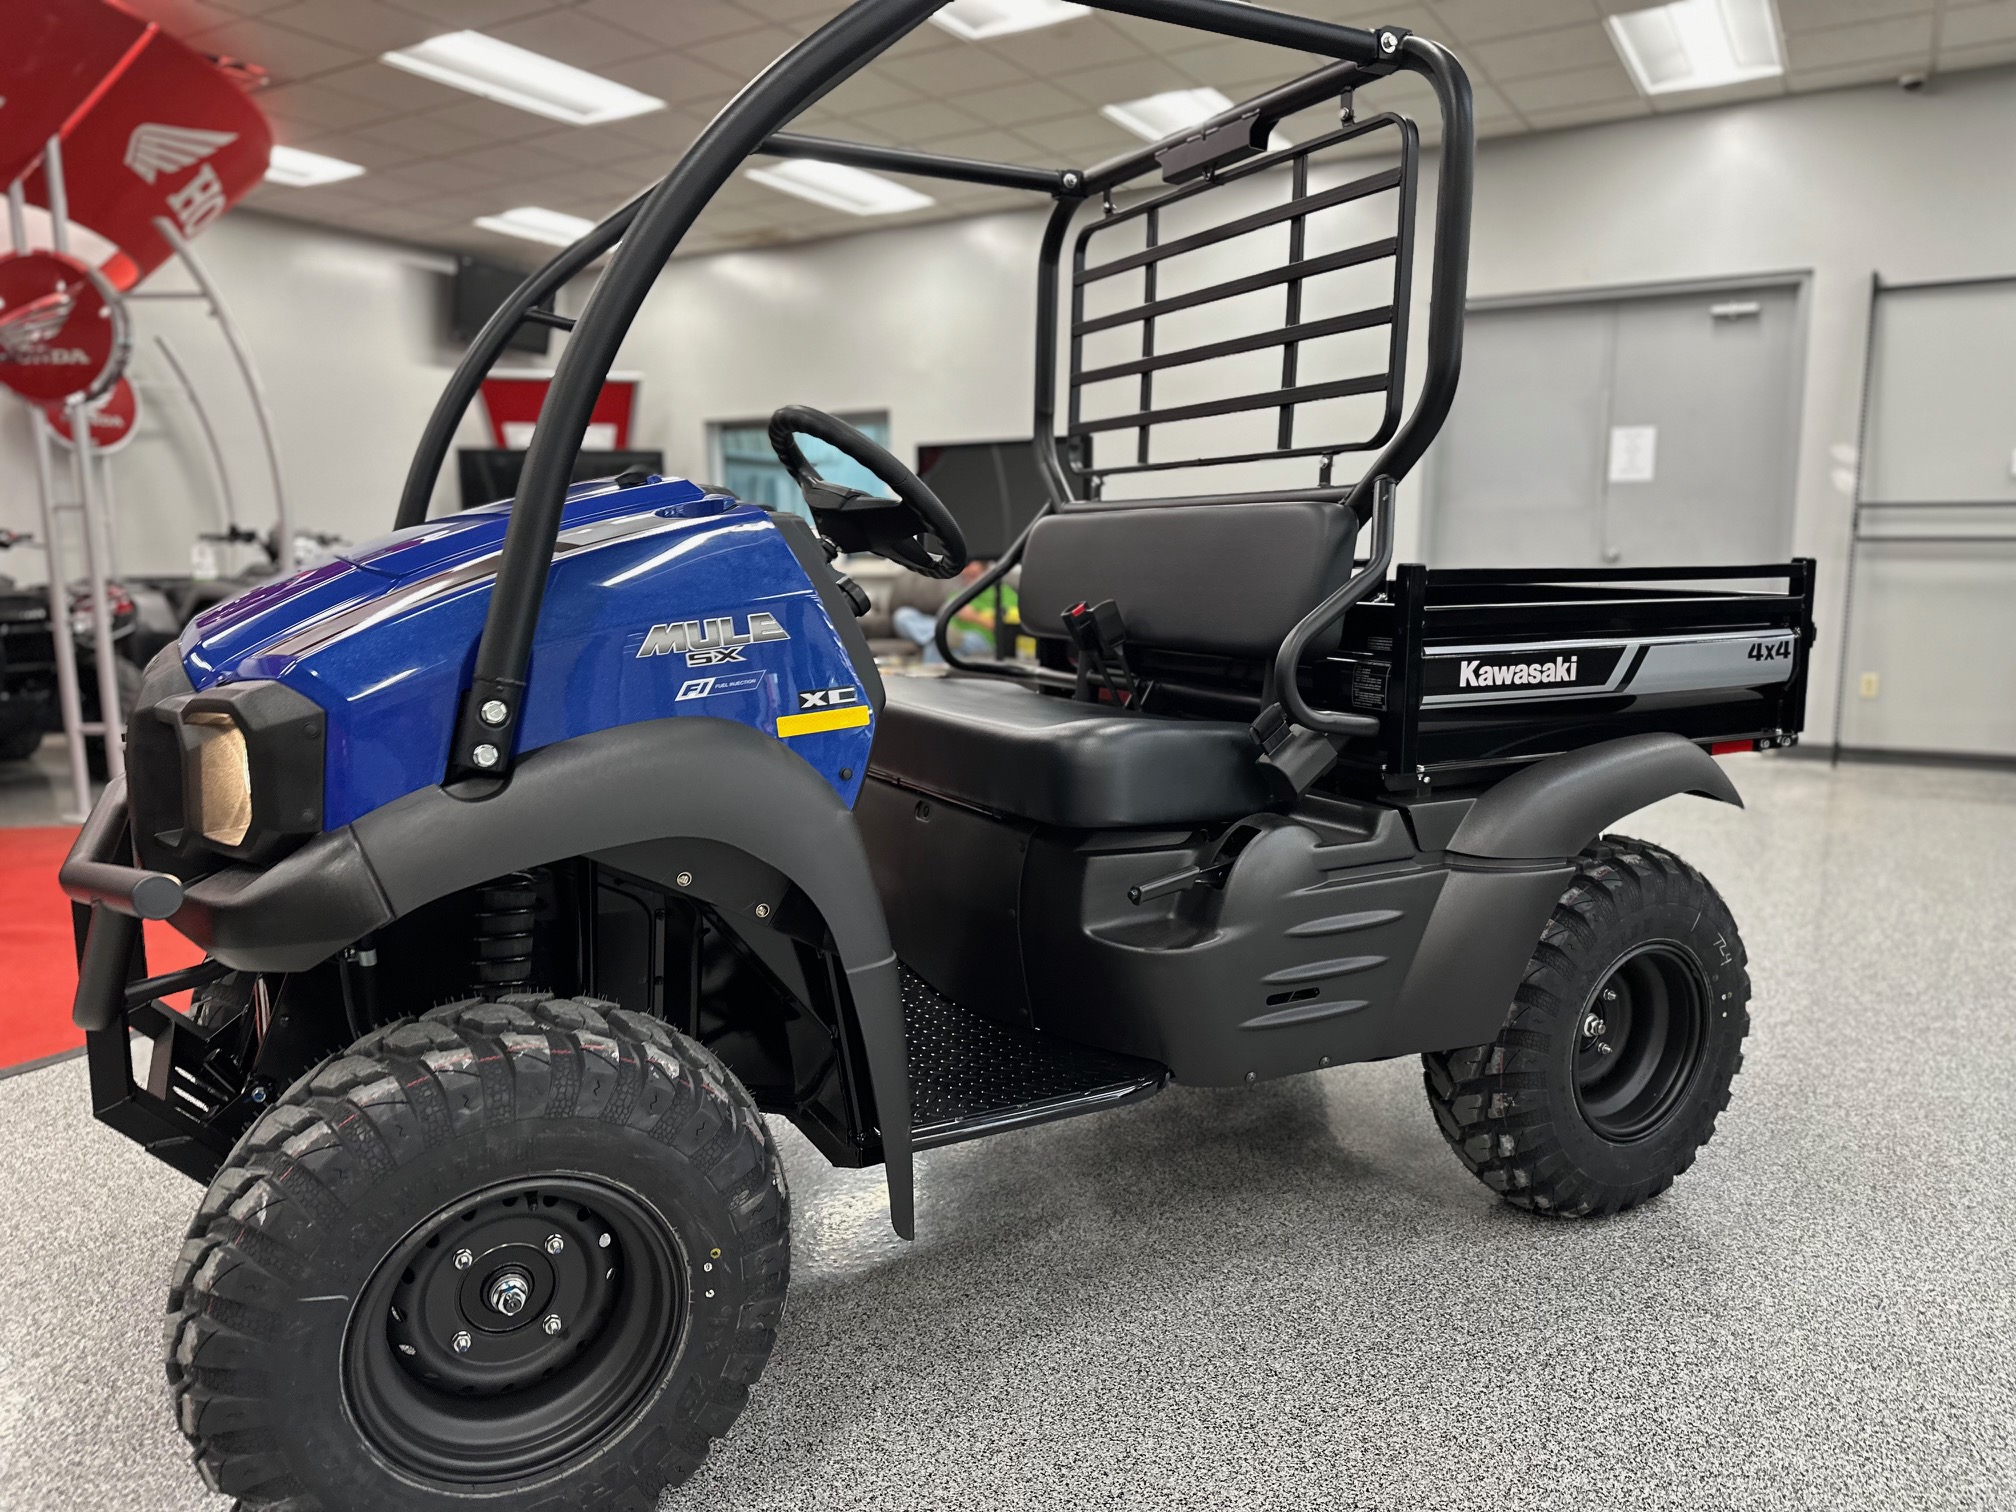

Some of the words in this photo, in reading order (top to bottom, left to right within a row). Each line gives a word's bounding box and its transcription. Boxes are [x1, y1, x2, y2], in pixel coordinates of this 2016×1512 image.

[636, 612, 791, 658] MULE
[687, 646, 746, 667] SX
[1747, 640, 1791, 661] 4x4
[1459, 656, 1577, 687] Kawasaki
[800, 687, 857, 708] XC
